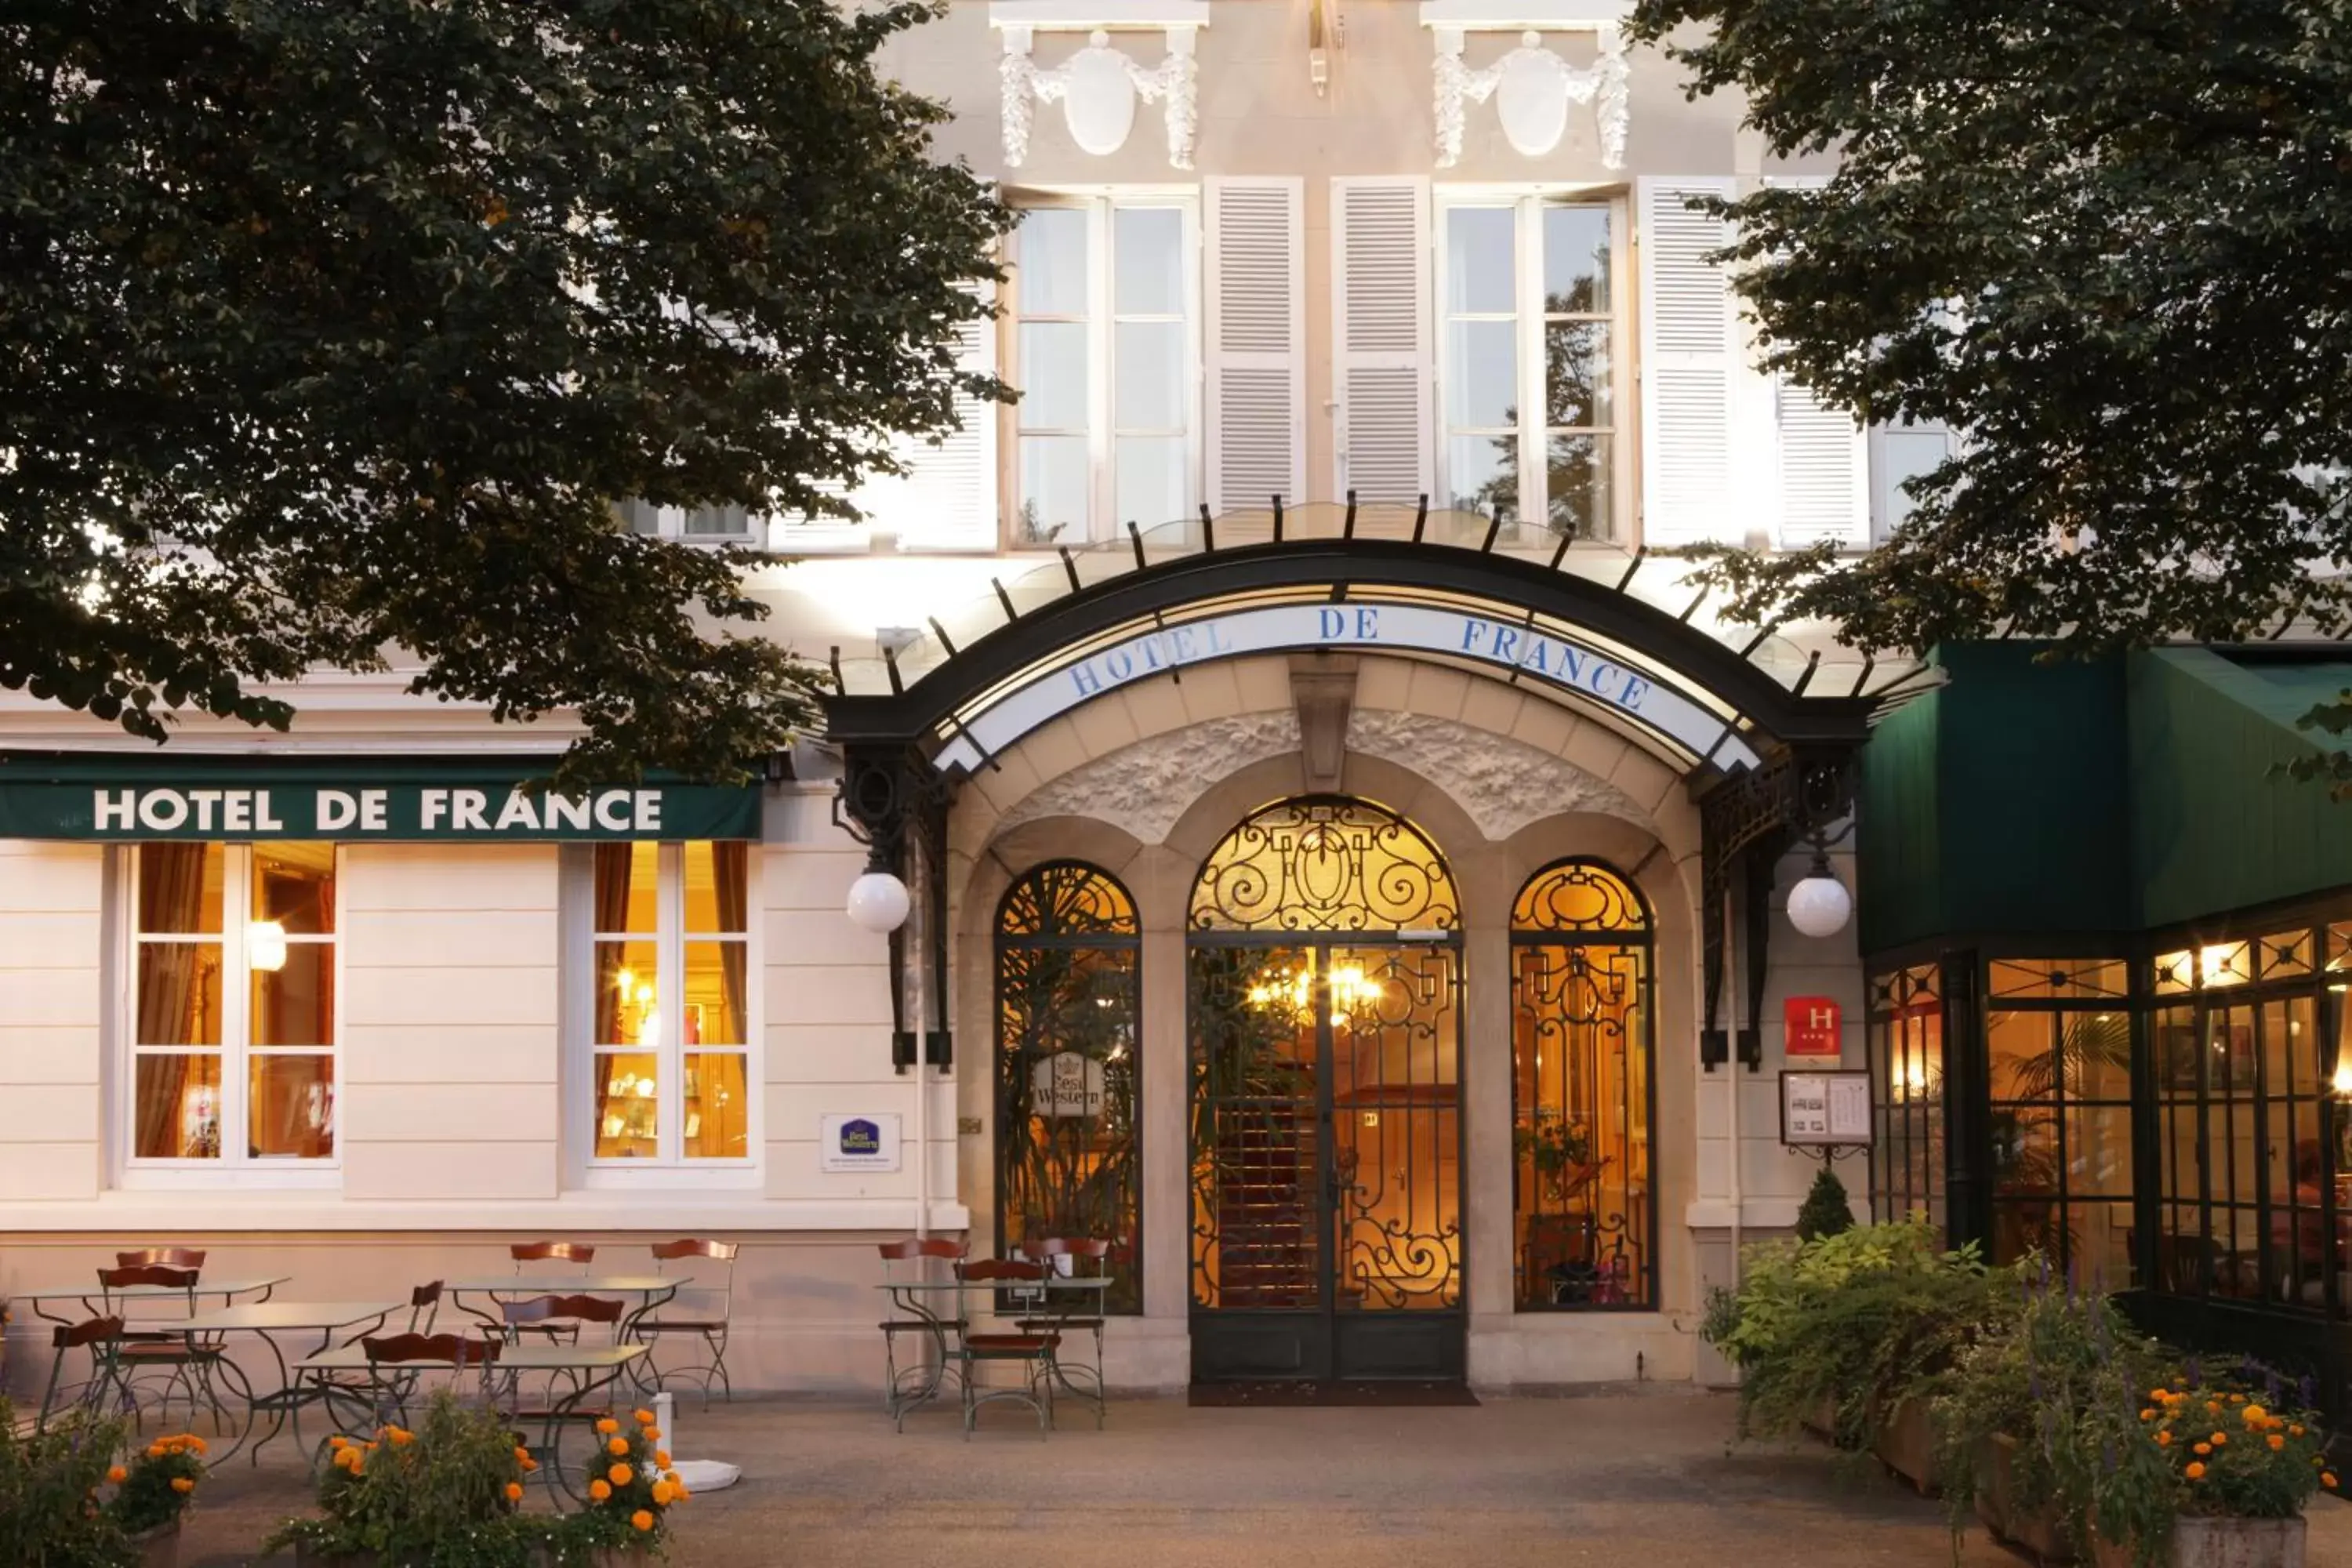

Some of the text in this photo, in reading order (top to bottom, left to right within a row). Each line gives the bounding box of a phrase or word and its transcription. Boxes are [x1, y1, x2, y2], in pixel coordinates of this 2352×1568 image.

[1071, 608, 1650, 710] HOTEL DE FRANCE
[94, 788, 662, 832] HOTEL DE FRANCE
[1810, 1007, 1832, 1029] H
